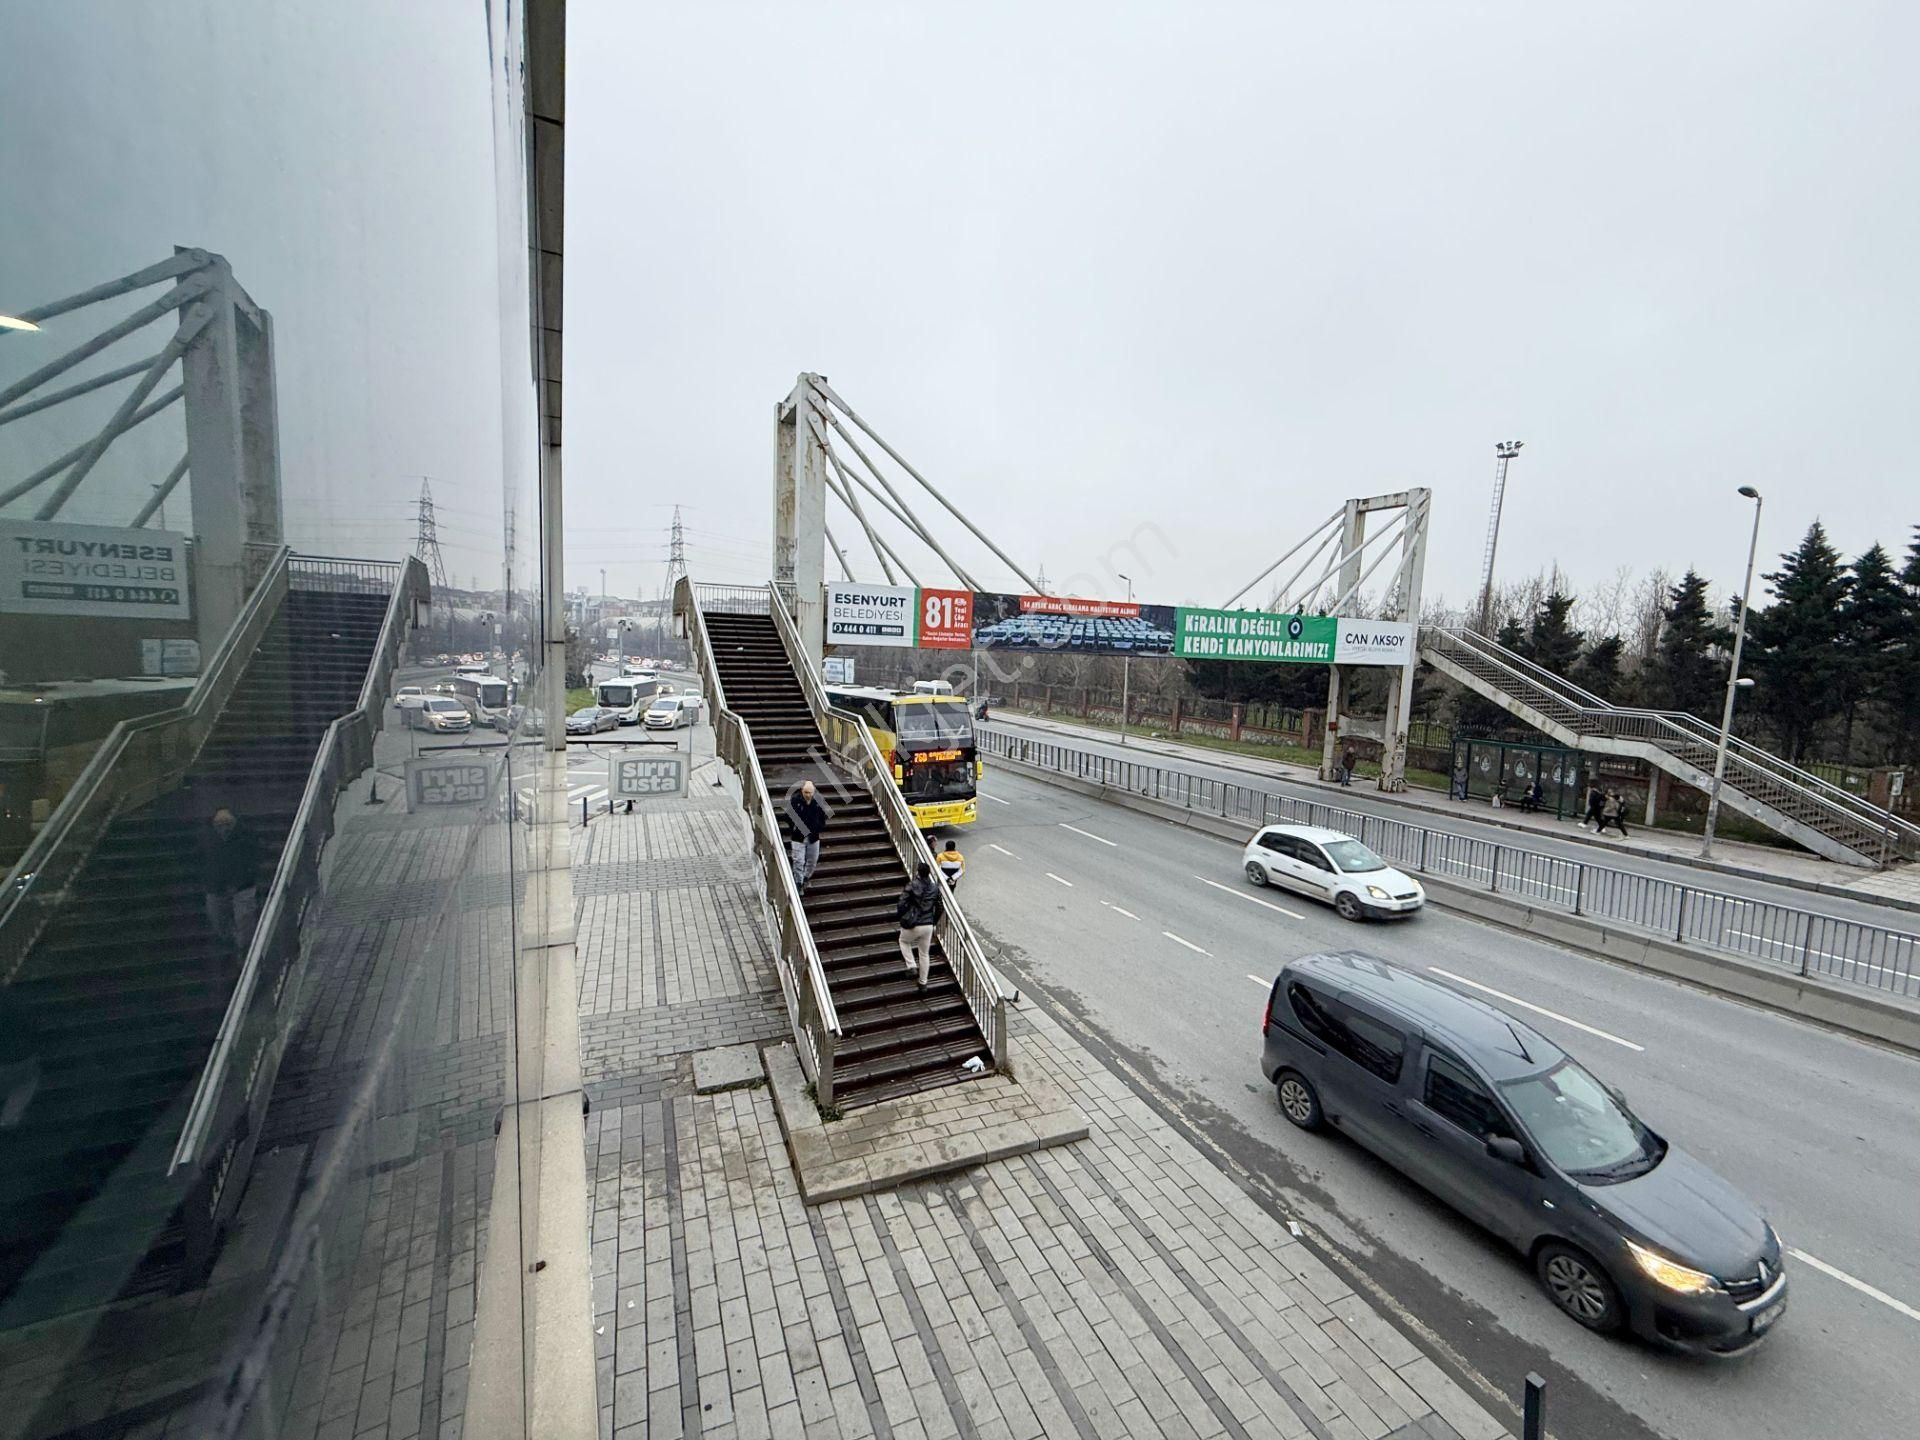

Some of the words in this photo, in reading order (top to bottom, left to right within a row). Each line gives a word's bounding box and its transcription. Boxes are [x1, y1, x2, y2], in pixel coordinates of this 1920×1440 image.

[834, 593, 906, 608] ESENYURT
[833, 607, 903, 621] BELEDİYESİ
[924, 595, 952, 629] 81
[843, 624, 858, 633] 444
[858, 624, 864, 633] 0
[865, 625, 877, 634] 411
[1185, 614, 1237, 635] KİRALIK
[1240, 616, 1281, 637] DEĞİL!
[1183, 635, 1223, 655] KENDİ
[1226, 639, 1329, 659] KAMYONLARIMIZ!
[1345, 632, 1369, 645] CAN
[1371, 634, 1405, 648] AKSOY
[622, 774, 677, 792] usta
